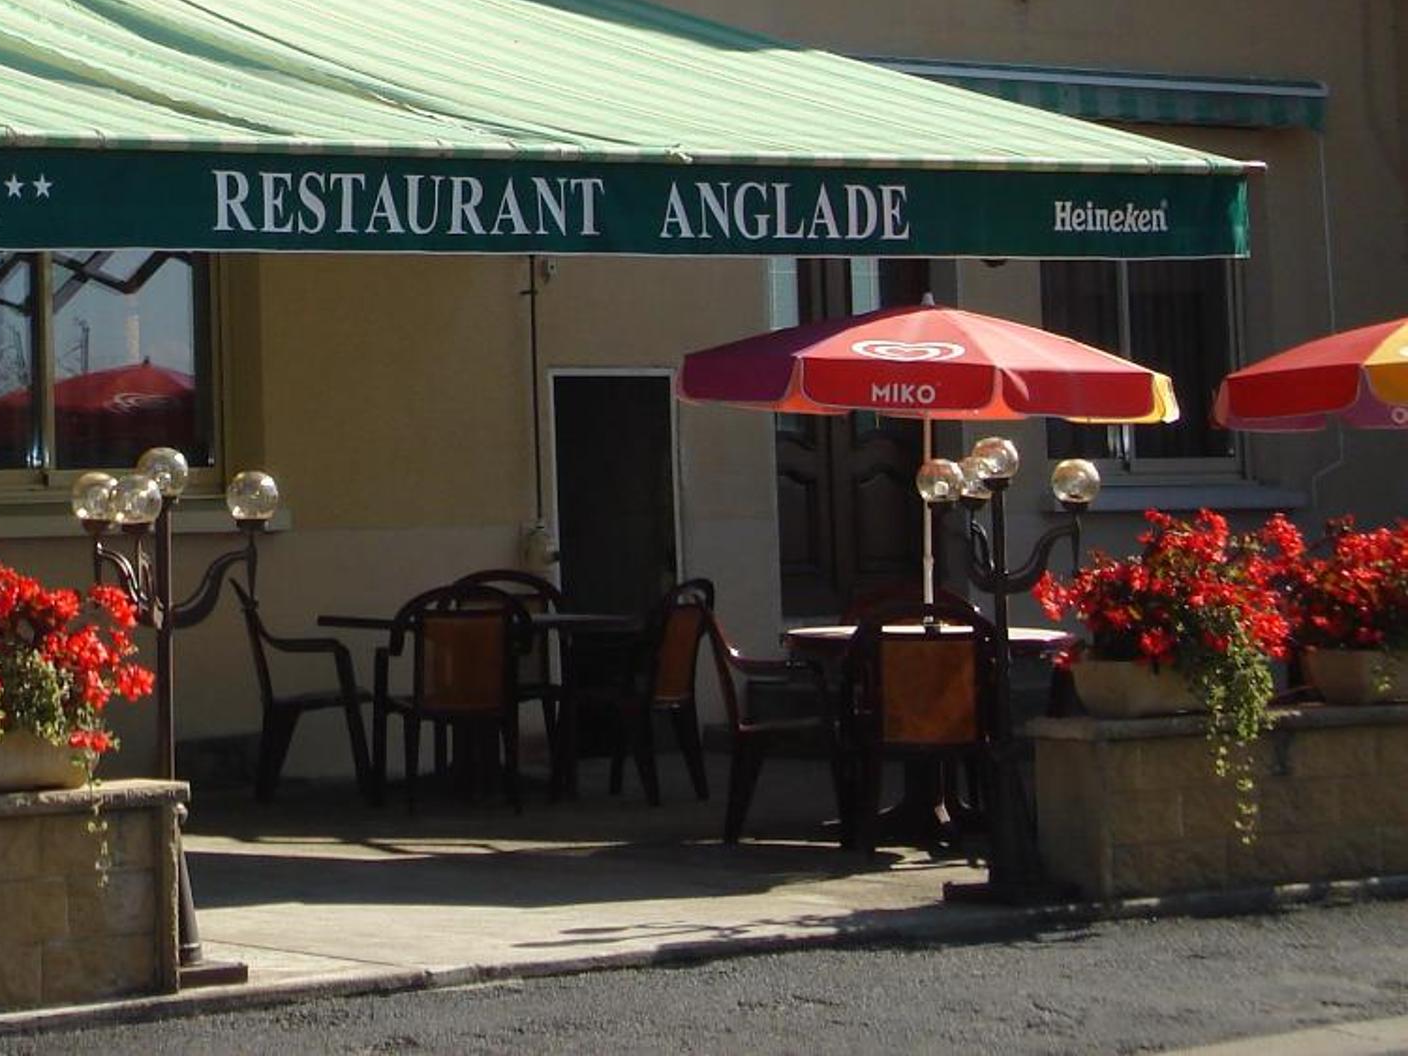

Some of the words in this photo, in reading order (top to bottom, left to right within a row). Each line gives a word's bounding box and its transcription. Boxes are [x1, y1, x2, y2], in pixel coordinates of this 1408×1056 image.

[211, 169, 606, 236] RESTAURANT
[659, 180, 911, 241] ANGLADE
[1054, 199, 1169, 233] Heineken
[871, 382, 936, 404] MIKO
